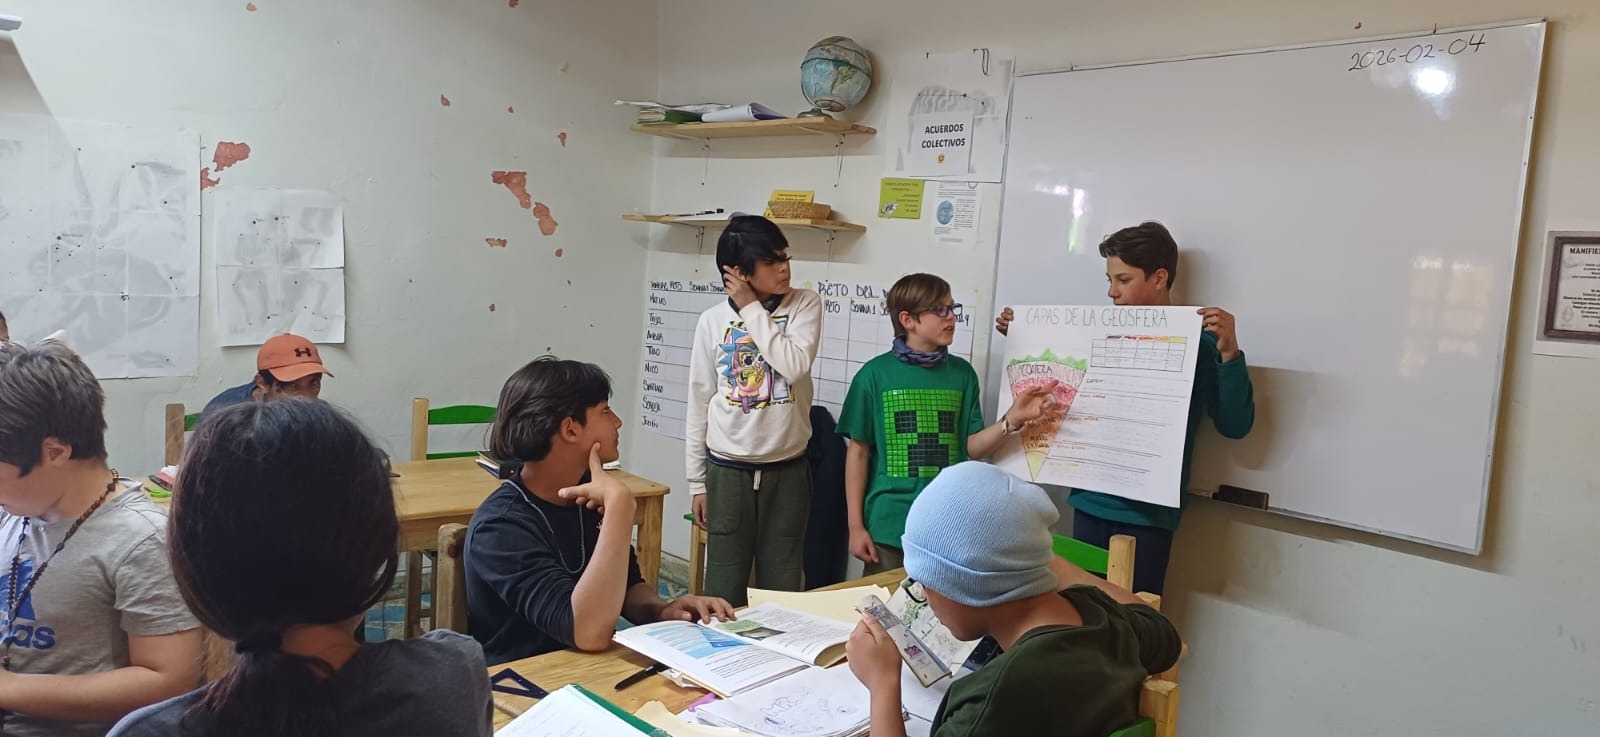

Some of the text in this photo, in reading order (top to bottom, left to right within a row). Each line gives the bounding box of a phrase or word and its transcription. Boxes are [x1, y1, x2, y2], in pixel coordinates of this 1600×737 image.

[1348, 33, 1486, 71] 2026-02-04
[924, 123, 964, 134] ACUERDOS
[921, 138, 966, 149] COLECTIVOS
[1025, 308, 1168, 328] CAPAS DE LA GEOSFERA
